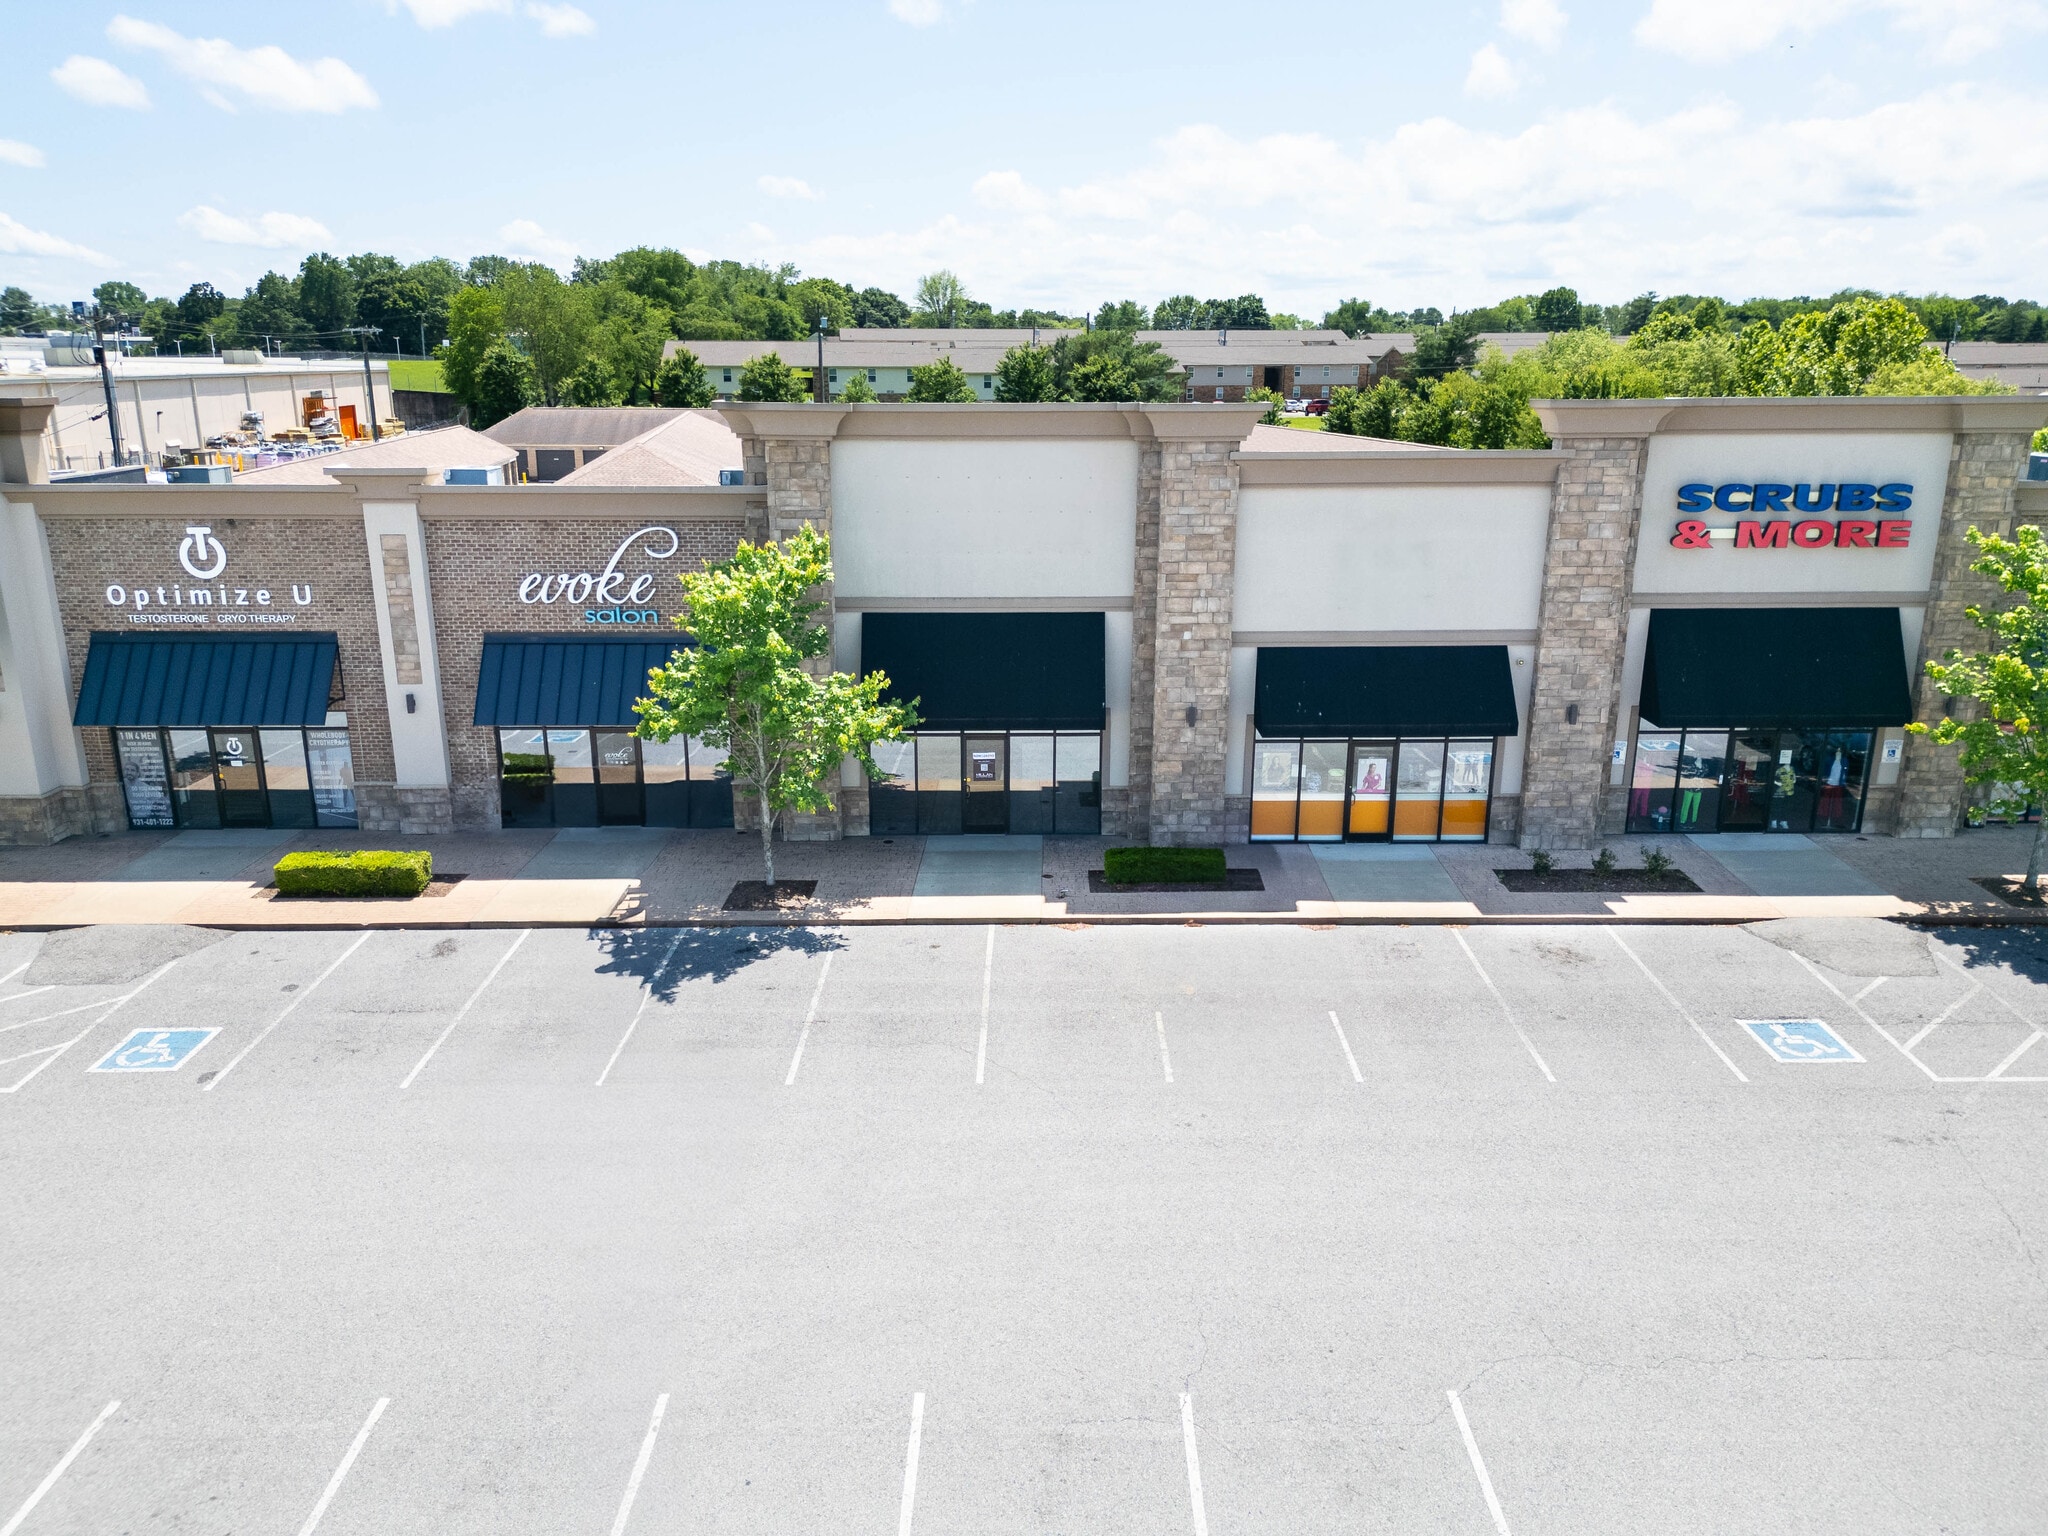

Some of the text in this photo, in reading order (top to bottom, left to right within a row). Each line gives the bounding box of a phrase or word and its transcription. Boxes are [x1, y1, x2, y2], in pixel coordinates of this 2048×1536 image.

[1677, 483, 1914, 512] SCRUBS
[1670, 520, 1912, 549] & MORE
[519, 526, 679, 604] evoke
[106, 584, 312, 611] Optimize U
[127, 614, 209, 623] TESTOSTERONE
[585, 606, 659, 625] salon
[125, 731, 133, 740] IN
[134, 731, 140, 740] 4
[140, 731, 157, 740] MEN
